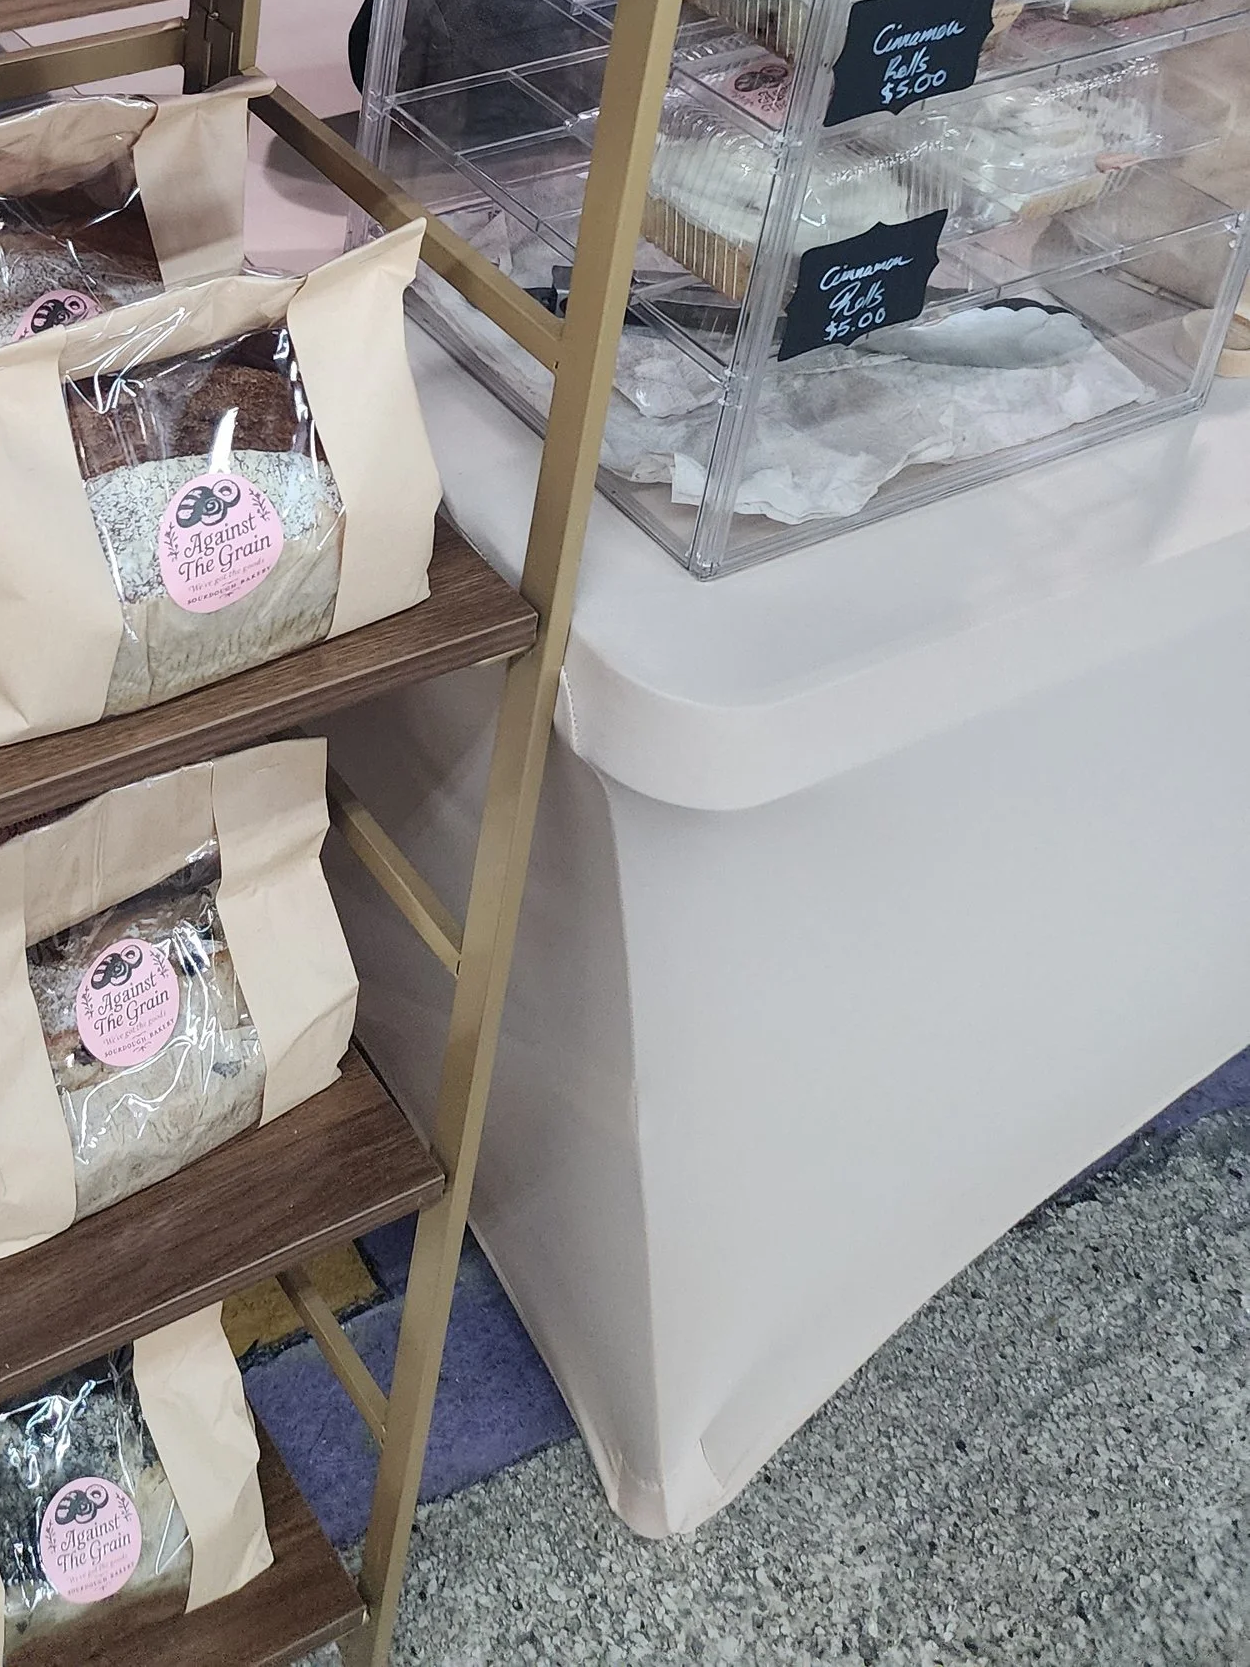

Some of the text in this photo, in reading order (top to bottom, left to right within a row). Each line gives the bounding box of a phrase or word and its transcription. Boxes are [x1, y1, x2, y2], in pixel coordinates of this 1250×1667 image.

[883, 46, 930, 82] Rolls
[881, 70, 946, 104] $5.00
[819, 254, 914, 291] Cinnamon
[828, 280, 886, 318] Rolls
[823, 308, 887, 342] $5.00
[184, 513, 257, 559] Against
[179, 535, 272, 583] The Grain
[98, 971, 157, 1015] Against
[94, 990, 170, 1037] The Grain
[61, 1514, 120, 1552] Against
[57, 1553, 87, 1573] The
[90, 1532, 131, 1566] Grain
